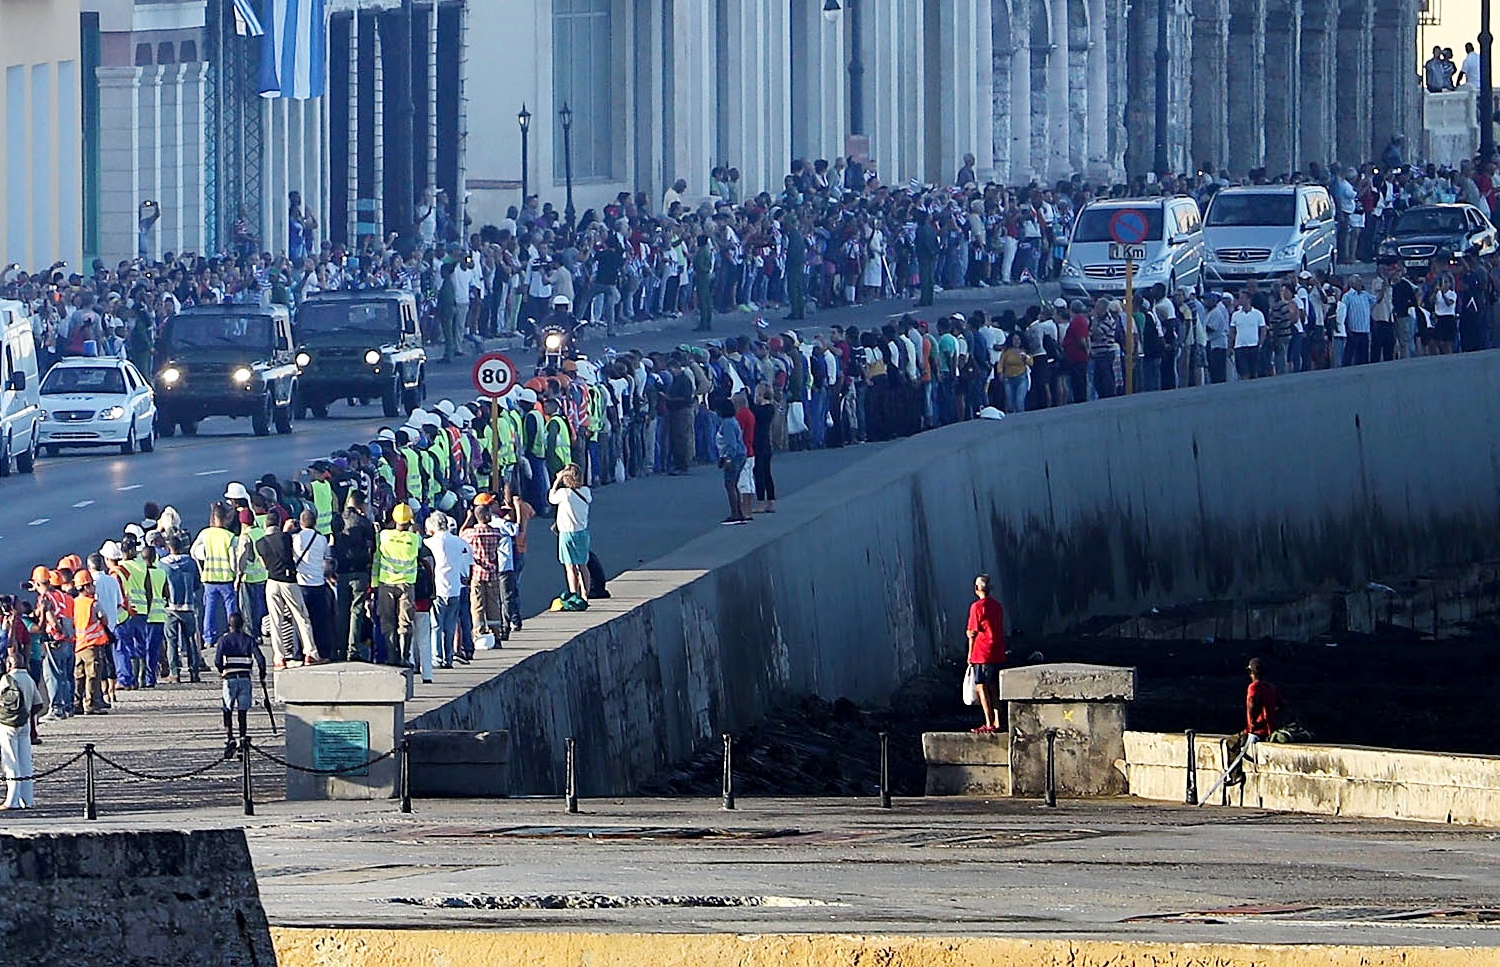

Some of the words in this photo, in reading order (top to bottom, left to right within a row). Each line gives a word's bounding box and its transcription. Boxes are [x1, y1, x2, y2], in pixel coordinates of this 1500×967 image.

[1113, 244, 1119, 258] 1
[1124, 244, 1144, 258] Km
[482, 368, 508, 384] 80
